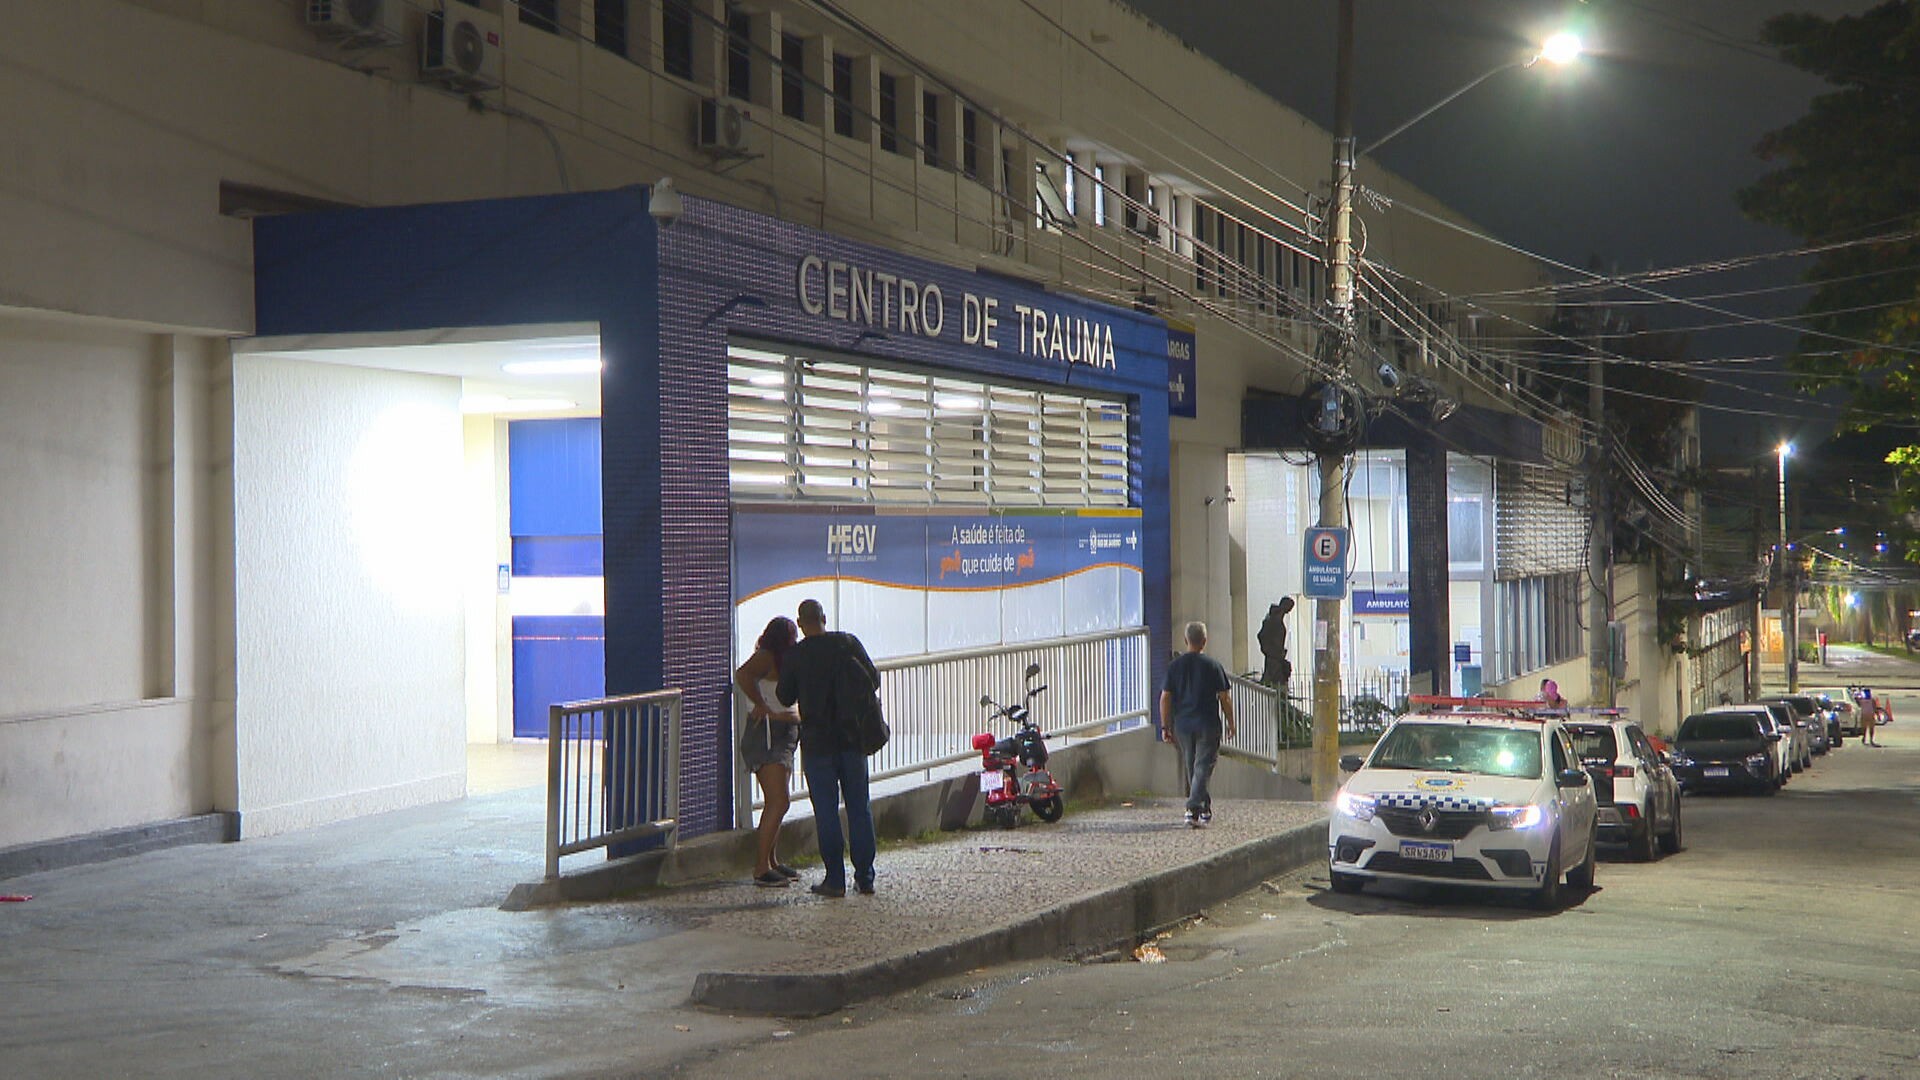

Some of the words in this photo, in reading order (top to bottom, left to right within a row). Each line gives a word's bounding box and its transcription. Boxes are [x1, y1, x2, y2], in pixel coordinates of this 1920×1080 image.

[798, 255, 943, 337] CENTRO
[962, 292, 999, 349] DE
[1014, 305, 1116, 370] TRAUMA
[827, 525, 876, 554] HEGV
[951, 525, 959, 544] A
[960, 524, 987, 544] saúde
[988, 525, 994, 544] é
[995, 525, 1014, 544] feita
[1014, 524, 1025, 544] de
[1321, 539, 1330, 556] E
[962, 558, 979, 577] que
[979, 553, 1002, 573] cuida
[1003, 553, 1014, 573] de
